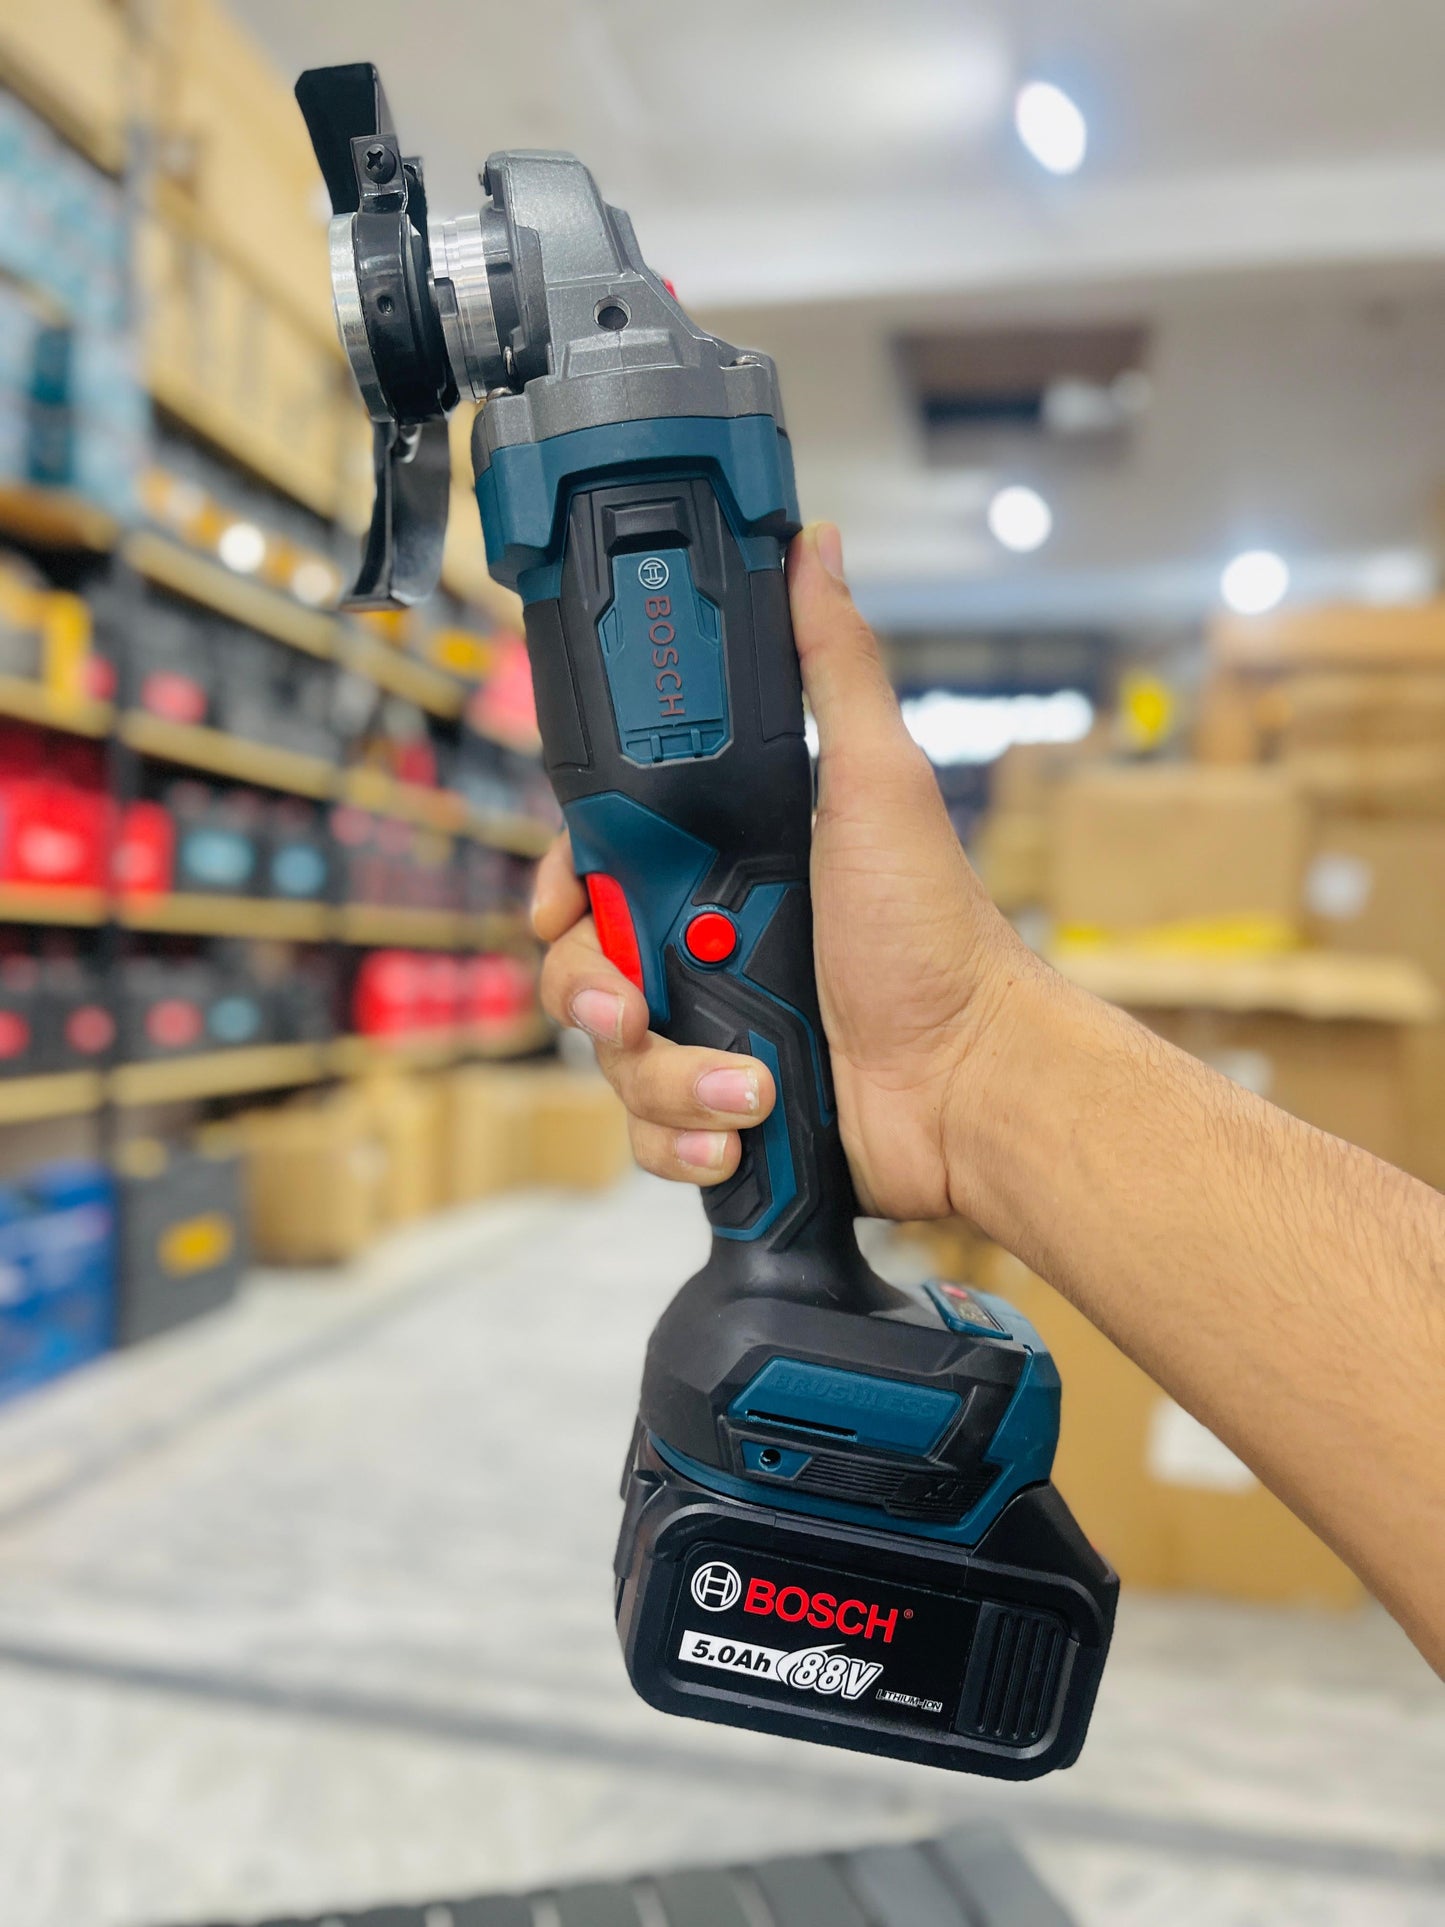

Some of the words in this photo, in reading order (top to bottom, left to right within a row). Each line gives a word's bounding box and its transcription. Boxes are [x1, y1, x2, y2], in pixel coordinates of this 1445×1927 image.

[644, 595, 686, 718] BOSCH
[744, 1577, 899, 1643] BOSCH
[691, 1639, 772, 1673] 5.0Ah
[789, 1650, 884, 1700] 88V
[876, 1688, 943, 1713] LITHIUM-ION
